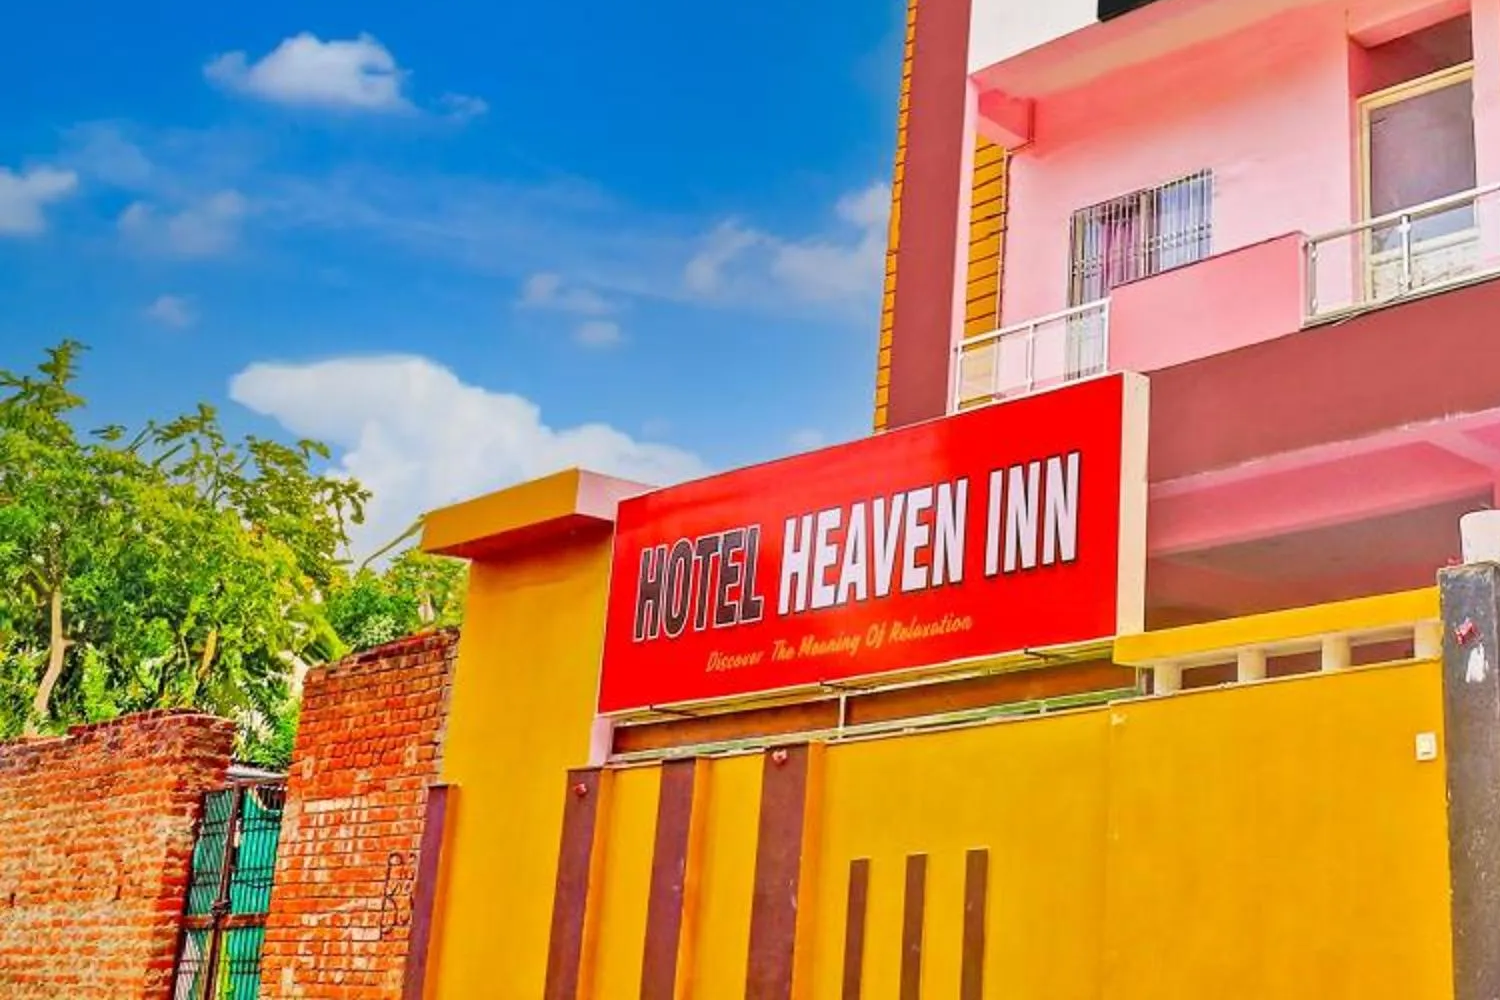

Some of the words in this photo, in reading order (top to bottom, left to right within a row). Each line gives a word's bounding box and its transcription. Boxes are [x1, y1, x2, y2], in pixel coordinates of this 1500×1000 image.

[633, 524, 764, 642] HOTEL
[778, 478, 969, 616] HEAVEN
[985, 452, 1081, 576] INN
[706, 650, 762, 673] Discover
[772, 639, 795, 661] The
[799, 633, 861, 660] Meaning
[866, 622, 886, 649] Of
[889, 613, 973, 642] Relaxation
